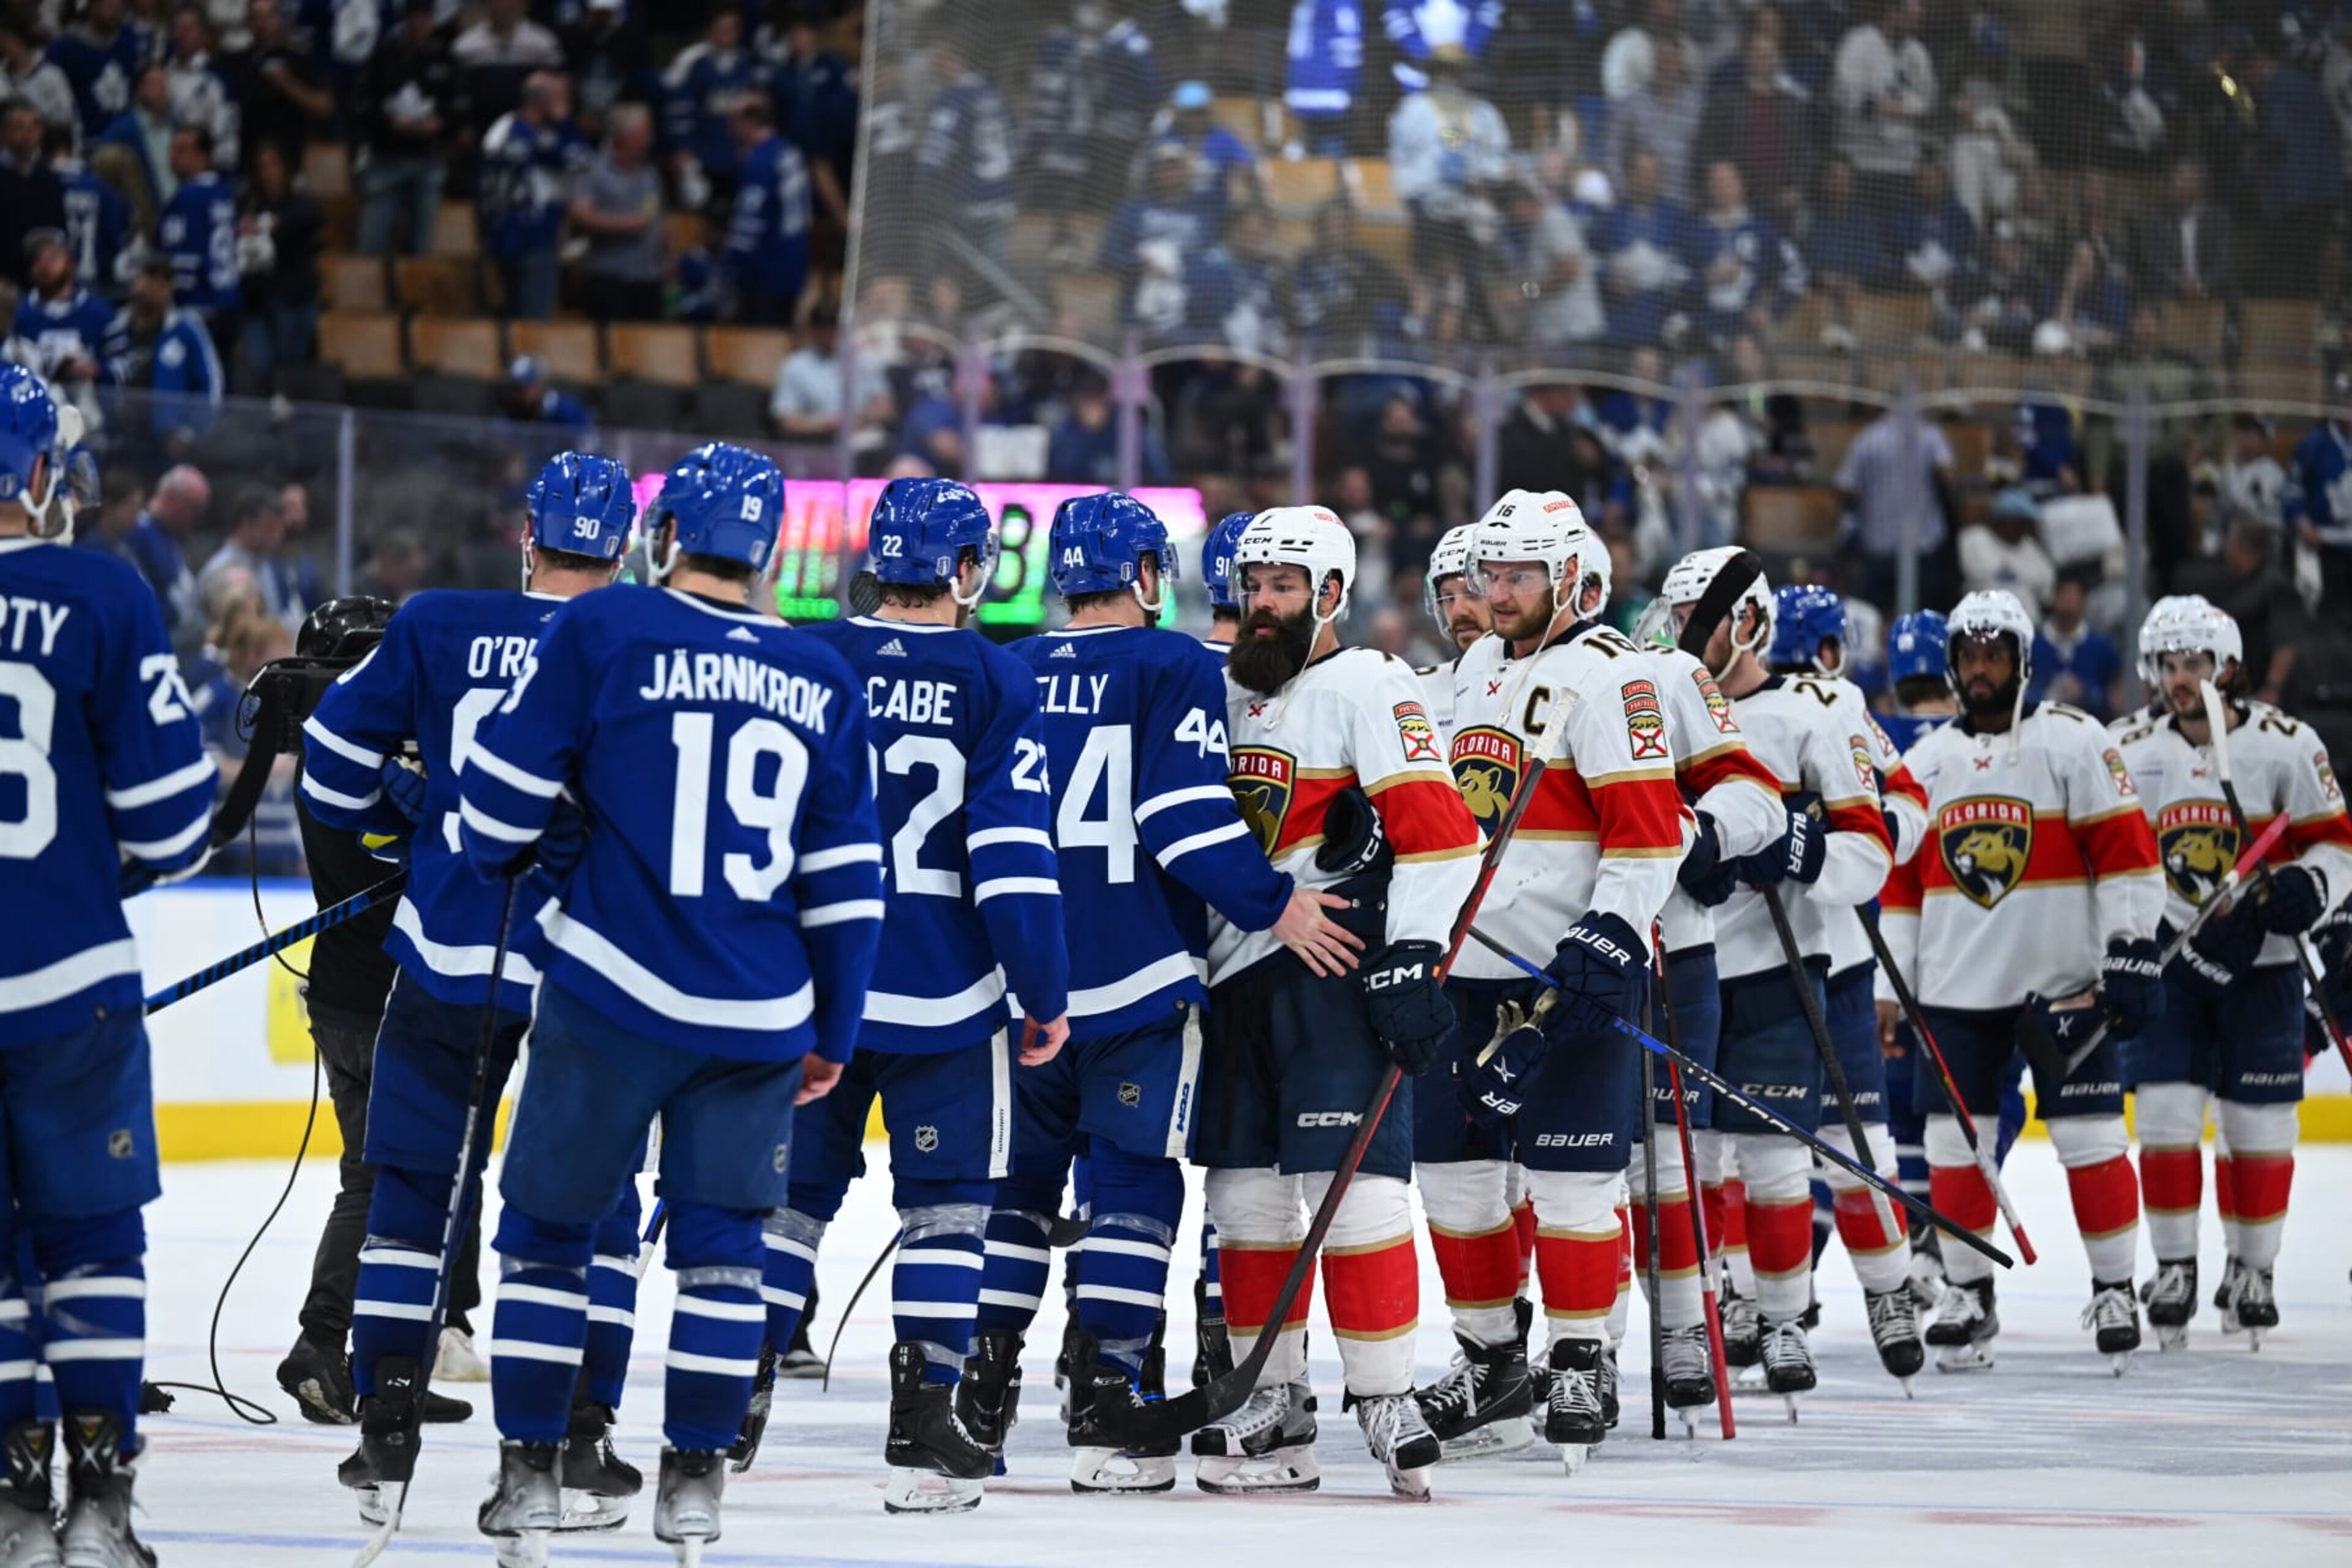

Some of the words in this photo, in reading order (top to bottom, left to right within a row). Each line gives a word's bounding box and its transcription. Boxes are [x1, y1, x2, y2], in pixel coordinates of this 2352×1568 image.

[740, 494, 763, 523] 19
[1496, 504, 1517, 518] 16
[573, 516, 601, 540] 90
[882, 535, 903, 557] 22
[1063, 546, 1084, 568] 44
[1215, 556, 1231, 577] 91
[639, 649, 832, 734] JÄRNKROK
[862, 676, 957, 725] CABE
[1523, 686, 1551, 736] C
[1174, 707, 1231, 773] 44
[1453, 736, 1510, 762] FLORIDA
[670, 711, 809, 902] 19
[1945, 803, 2022, 827] FLORIDA
[1740, 1084, 1809, 1099] CCM
[2060, 1082, 2120, 1098] BAUER
[1297, 1112, 1363, 1128] CCM
[1535, 1133, 1613, 1147] BAUER
